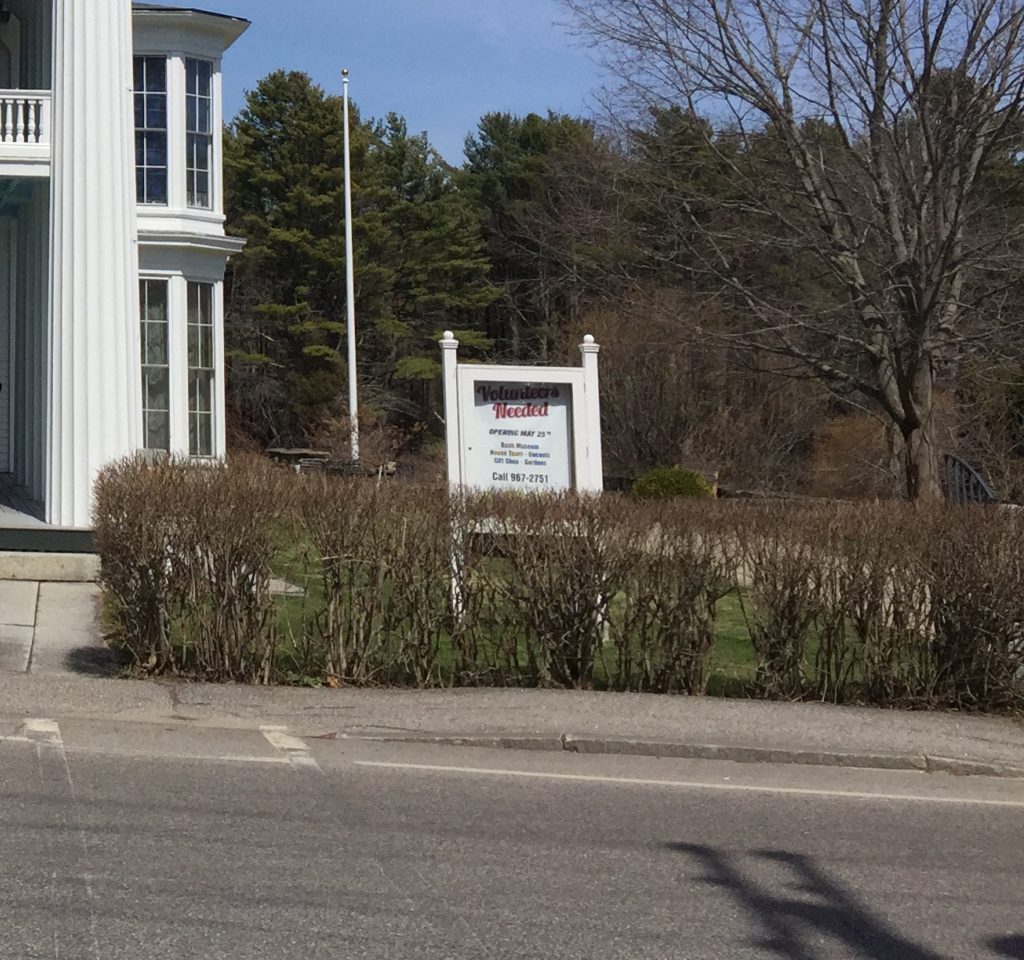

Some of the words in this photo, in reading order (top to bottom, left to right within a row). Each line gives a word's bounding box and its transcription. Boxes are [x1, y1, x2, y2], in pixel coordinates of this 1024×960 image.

[477, 385, 560, 401] Volunteers
[493, 402, 548, 419] Needed
[492, 472, 508, 481] Call
[511, 473, 548, 483] 967-2751
